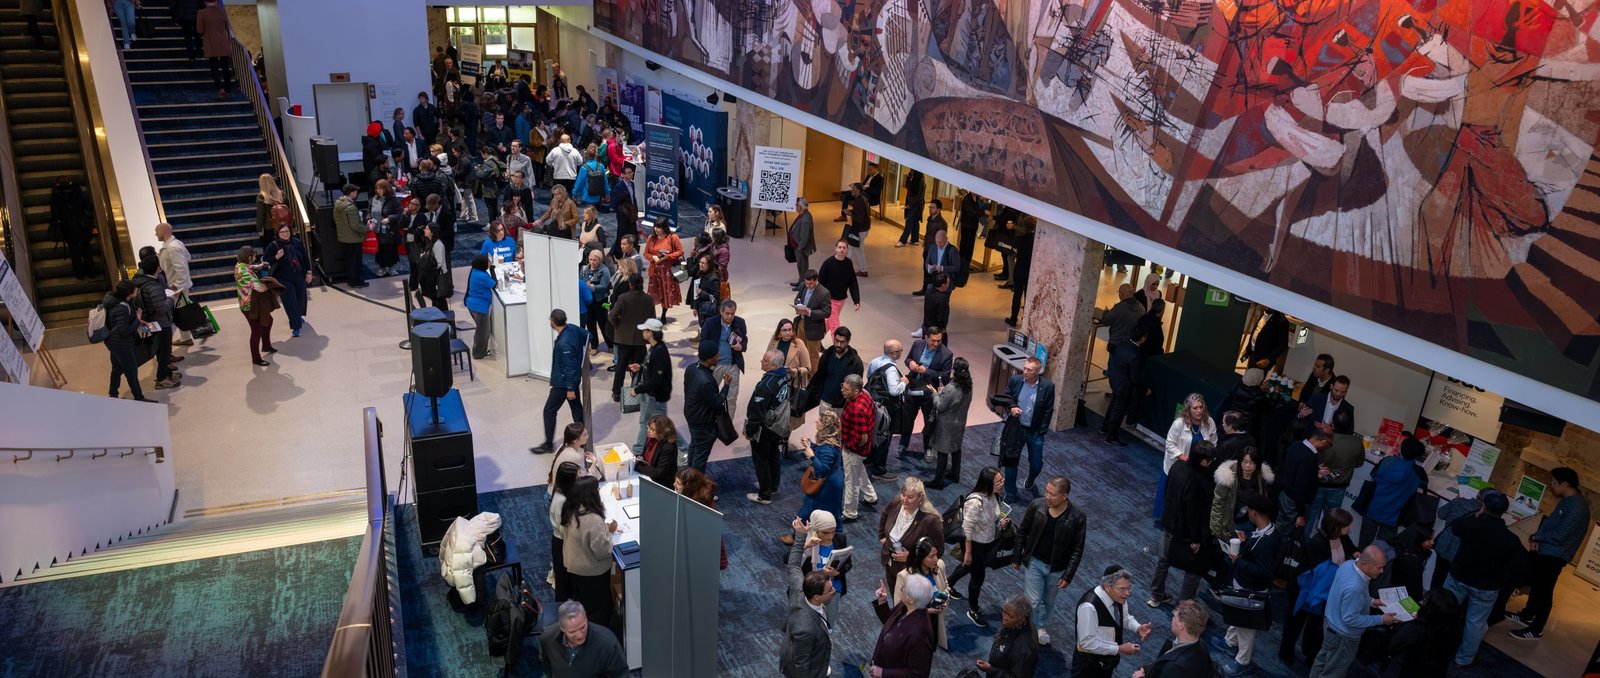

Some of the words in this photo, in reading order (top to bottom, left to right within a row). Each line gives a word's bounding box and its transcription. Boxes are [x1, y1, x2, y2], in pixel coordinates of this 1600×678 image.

[1209, 288, 1228, 302] TD
[1441, 393, 1472, 409] Advising.
[1443, 386, 1479, 403] Financing.
[1440, 399, 1478, 418] Know-how.
